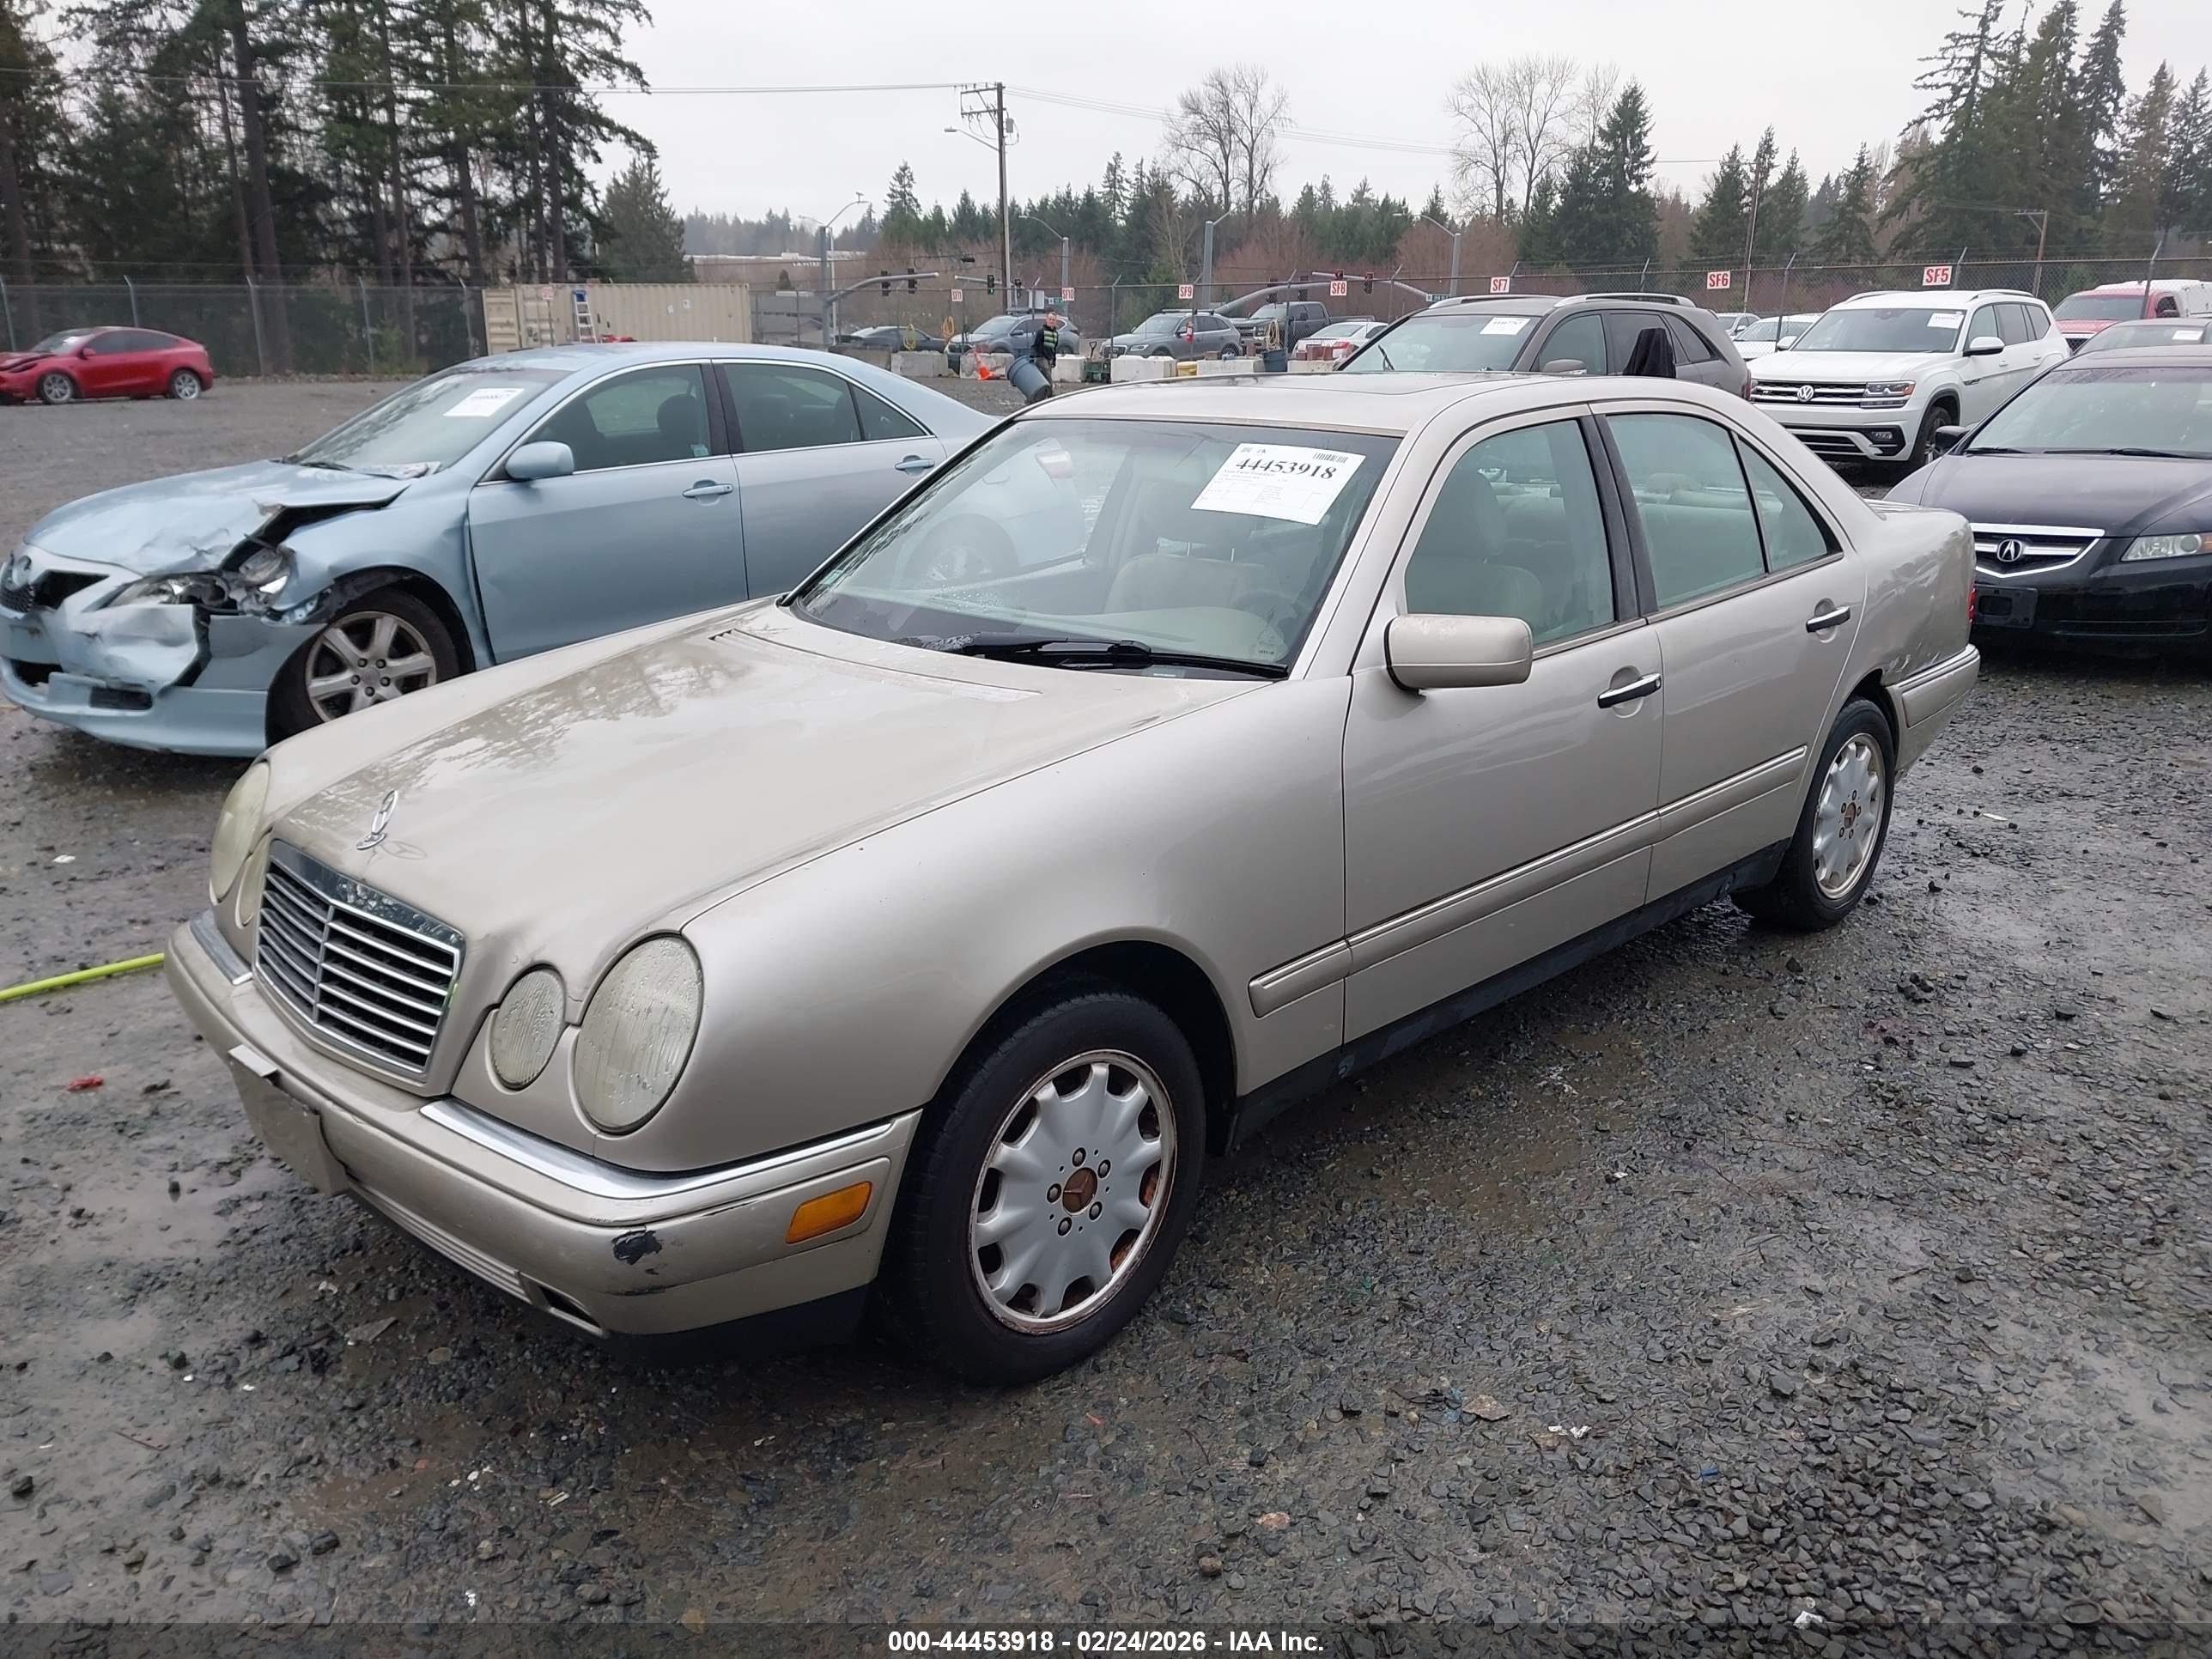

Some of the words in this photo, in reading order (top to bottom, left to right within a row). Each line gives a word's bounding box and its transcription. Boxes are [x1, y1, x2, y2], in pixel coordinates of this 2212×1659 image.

[1709, 273, 1729, 288] SF6
[1925, 268, 1949, 283] SF5
[1180, 286, 1192, 297] SF9
[1332, 283, 1346, 295] SF8
[1492, 279, 1508, 291] SF7
[1237, 458, 1337, 480] 44453918
